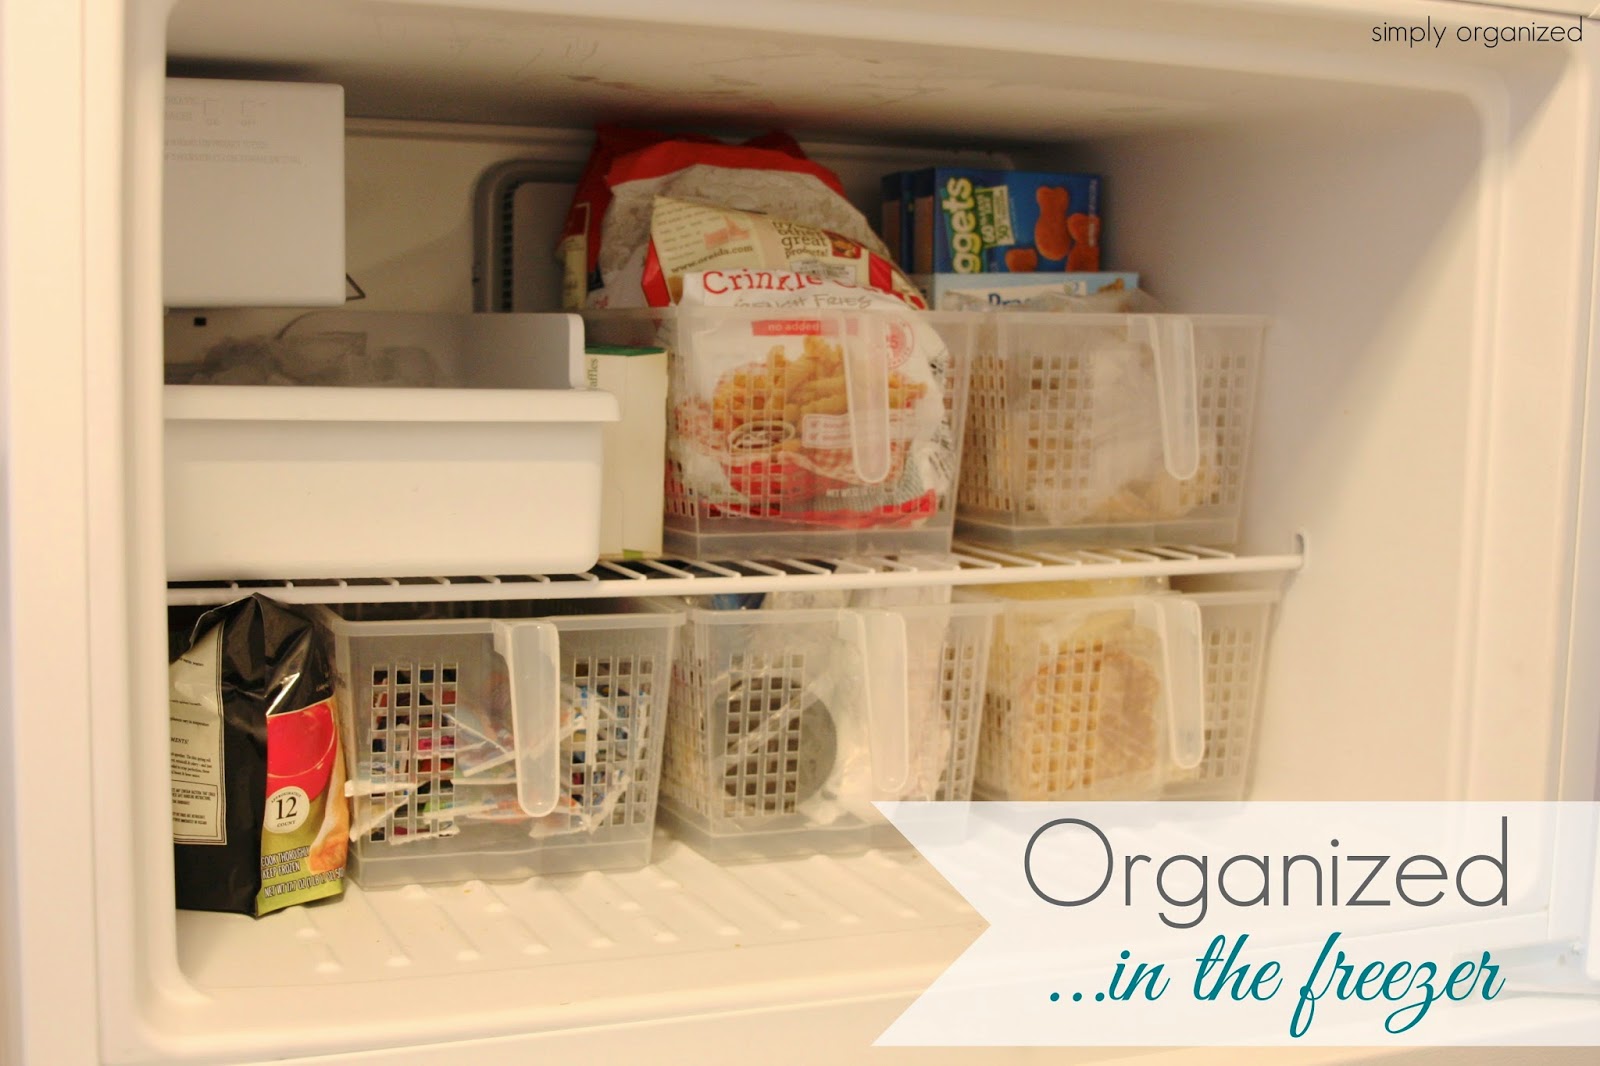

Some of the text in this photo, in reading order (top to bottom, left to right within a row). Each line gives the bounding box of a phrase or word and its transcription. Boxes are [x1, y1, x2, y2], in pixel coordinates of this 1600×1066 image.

[781, 236, 828, 250] great
[275, 797, 298, 820] 12
[276, 820, 296, 828] COUNT
[261, 854, 278, 867] COOK
[262, 861, 301, 880] KEEP FROZEN
[264, 885, 276, 898] NET
[276, 883, 286, 895] WT
